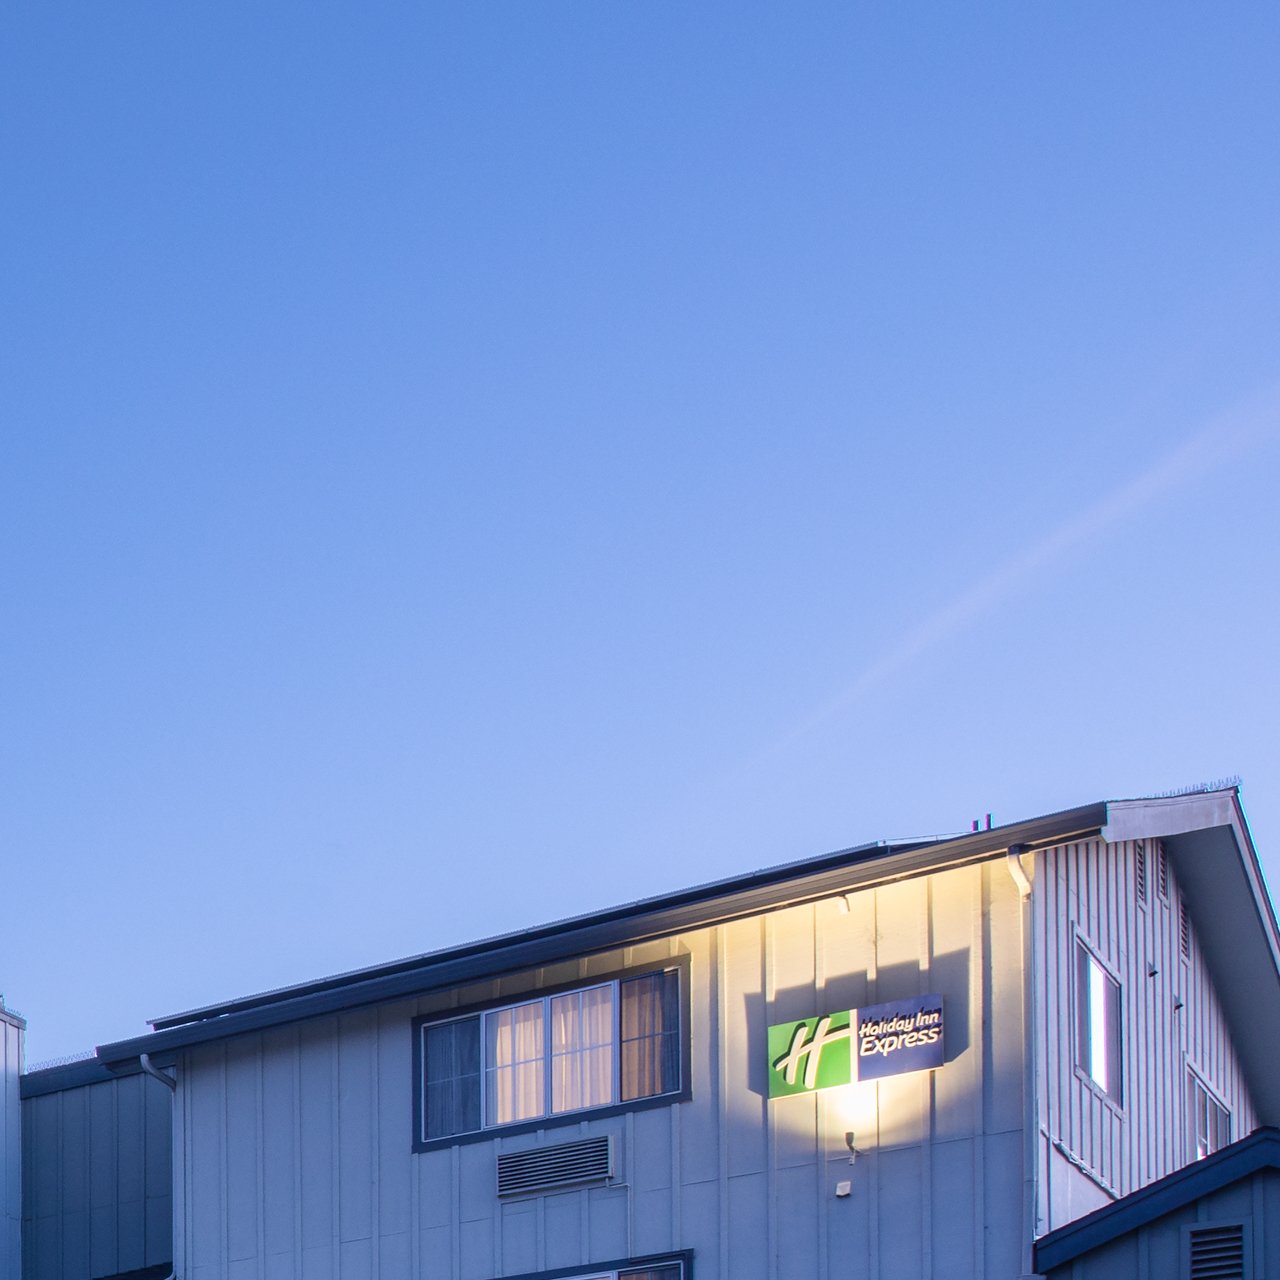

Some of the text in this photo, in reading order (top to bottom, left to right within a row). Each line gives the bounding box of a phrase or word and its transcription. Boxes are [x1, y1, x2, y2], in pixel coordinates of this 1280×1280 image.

[858, 1011, 939, 1038] Holiday Inn
[859, 1026, 940, 1056] Express
